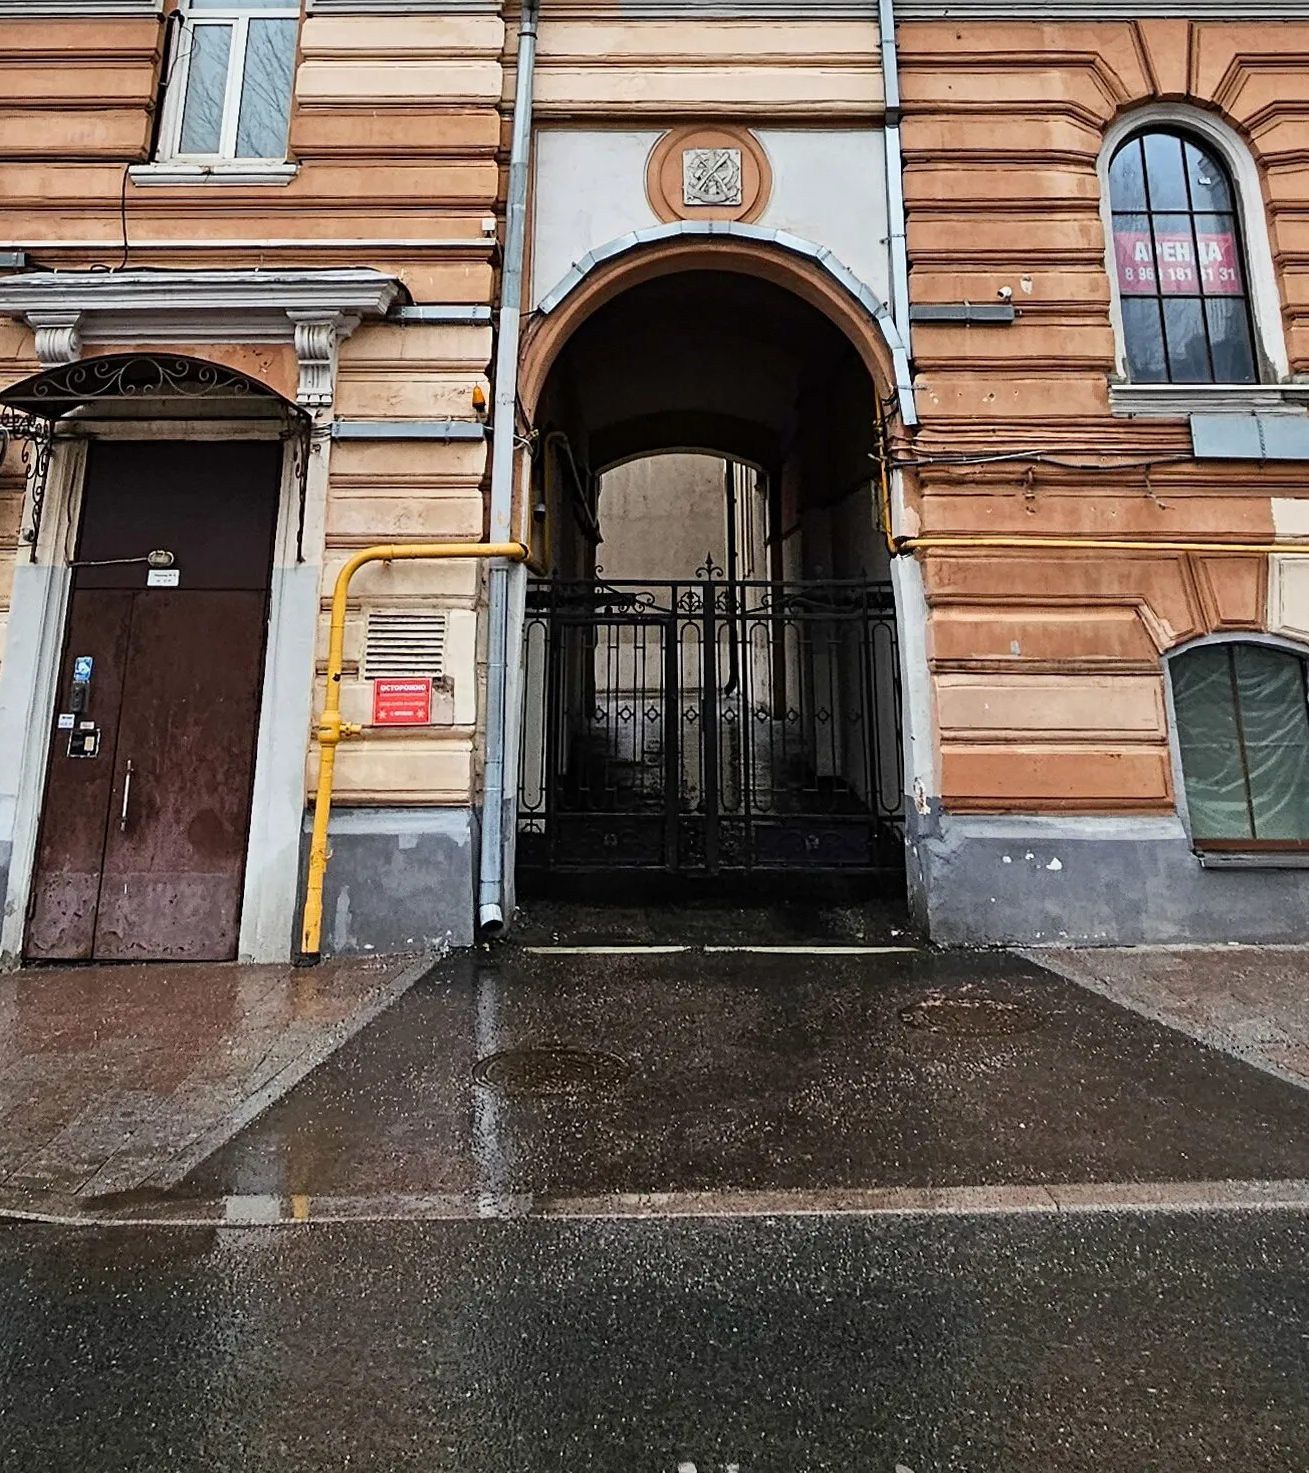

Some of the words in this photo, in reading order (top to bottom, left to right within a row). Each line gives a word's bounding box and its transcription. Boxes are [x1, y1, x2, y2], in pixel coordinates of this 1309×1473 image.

[1134, 241, 1223, 264] АРЕНДА
[1125, 267, 1133, 280] 8
[1219, 267, 1235, 281] 31
